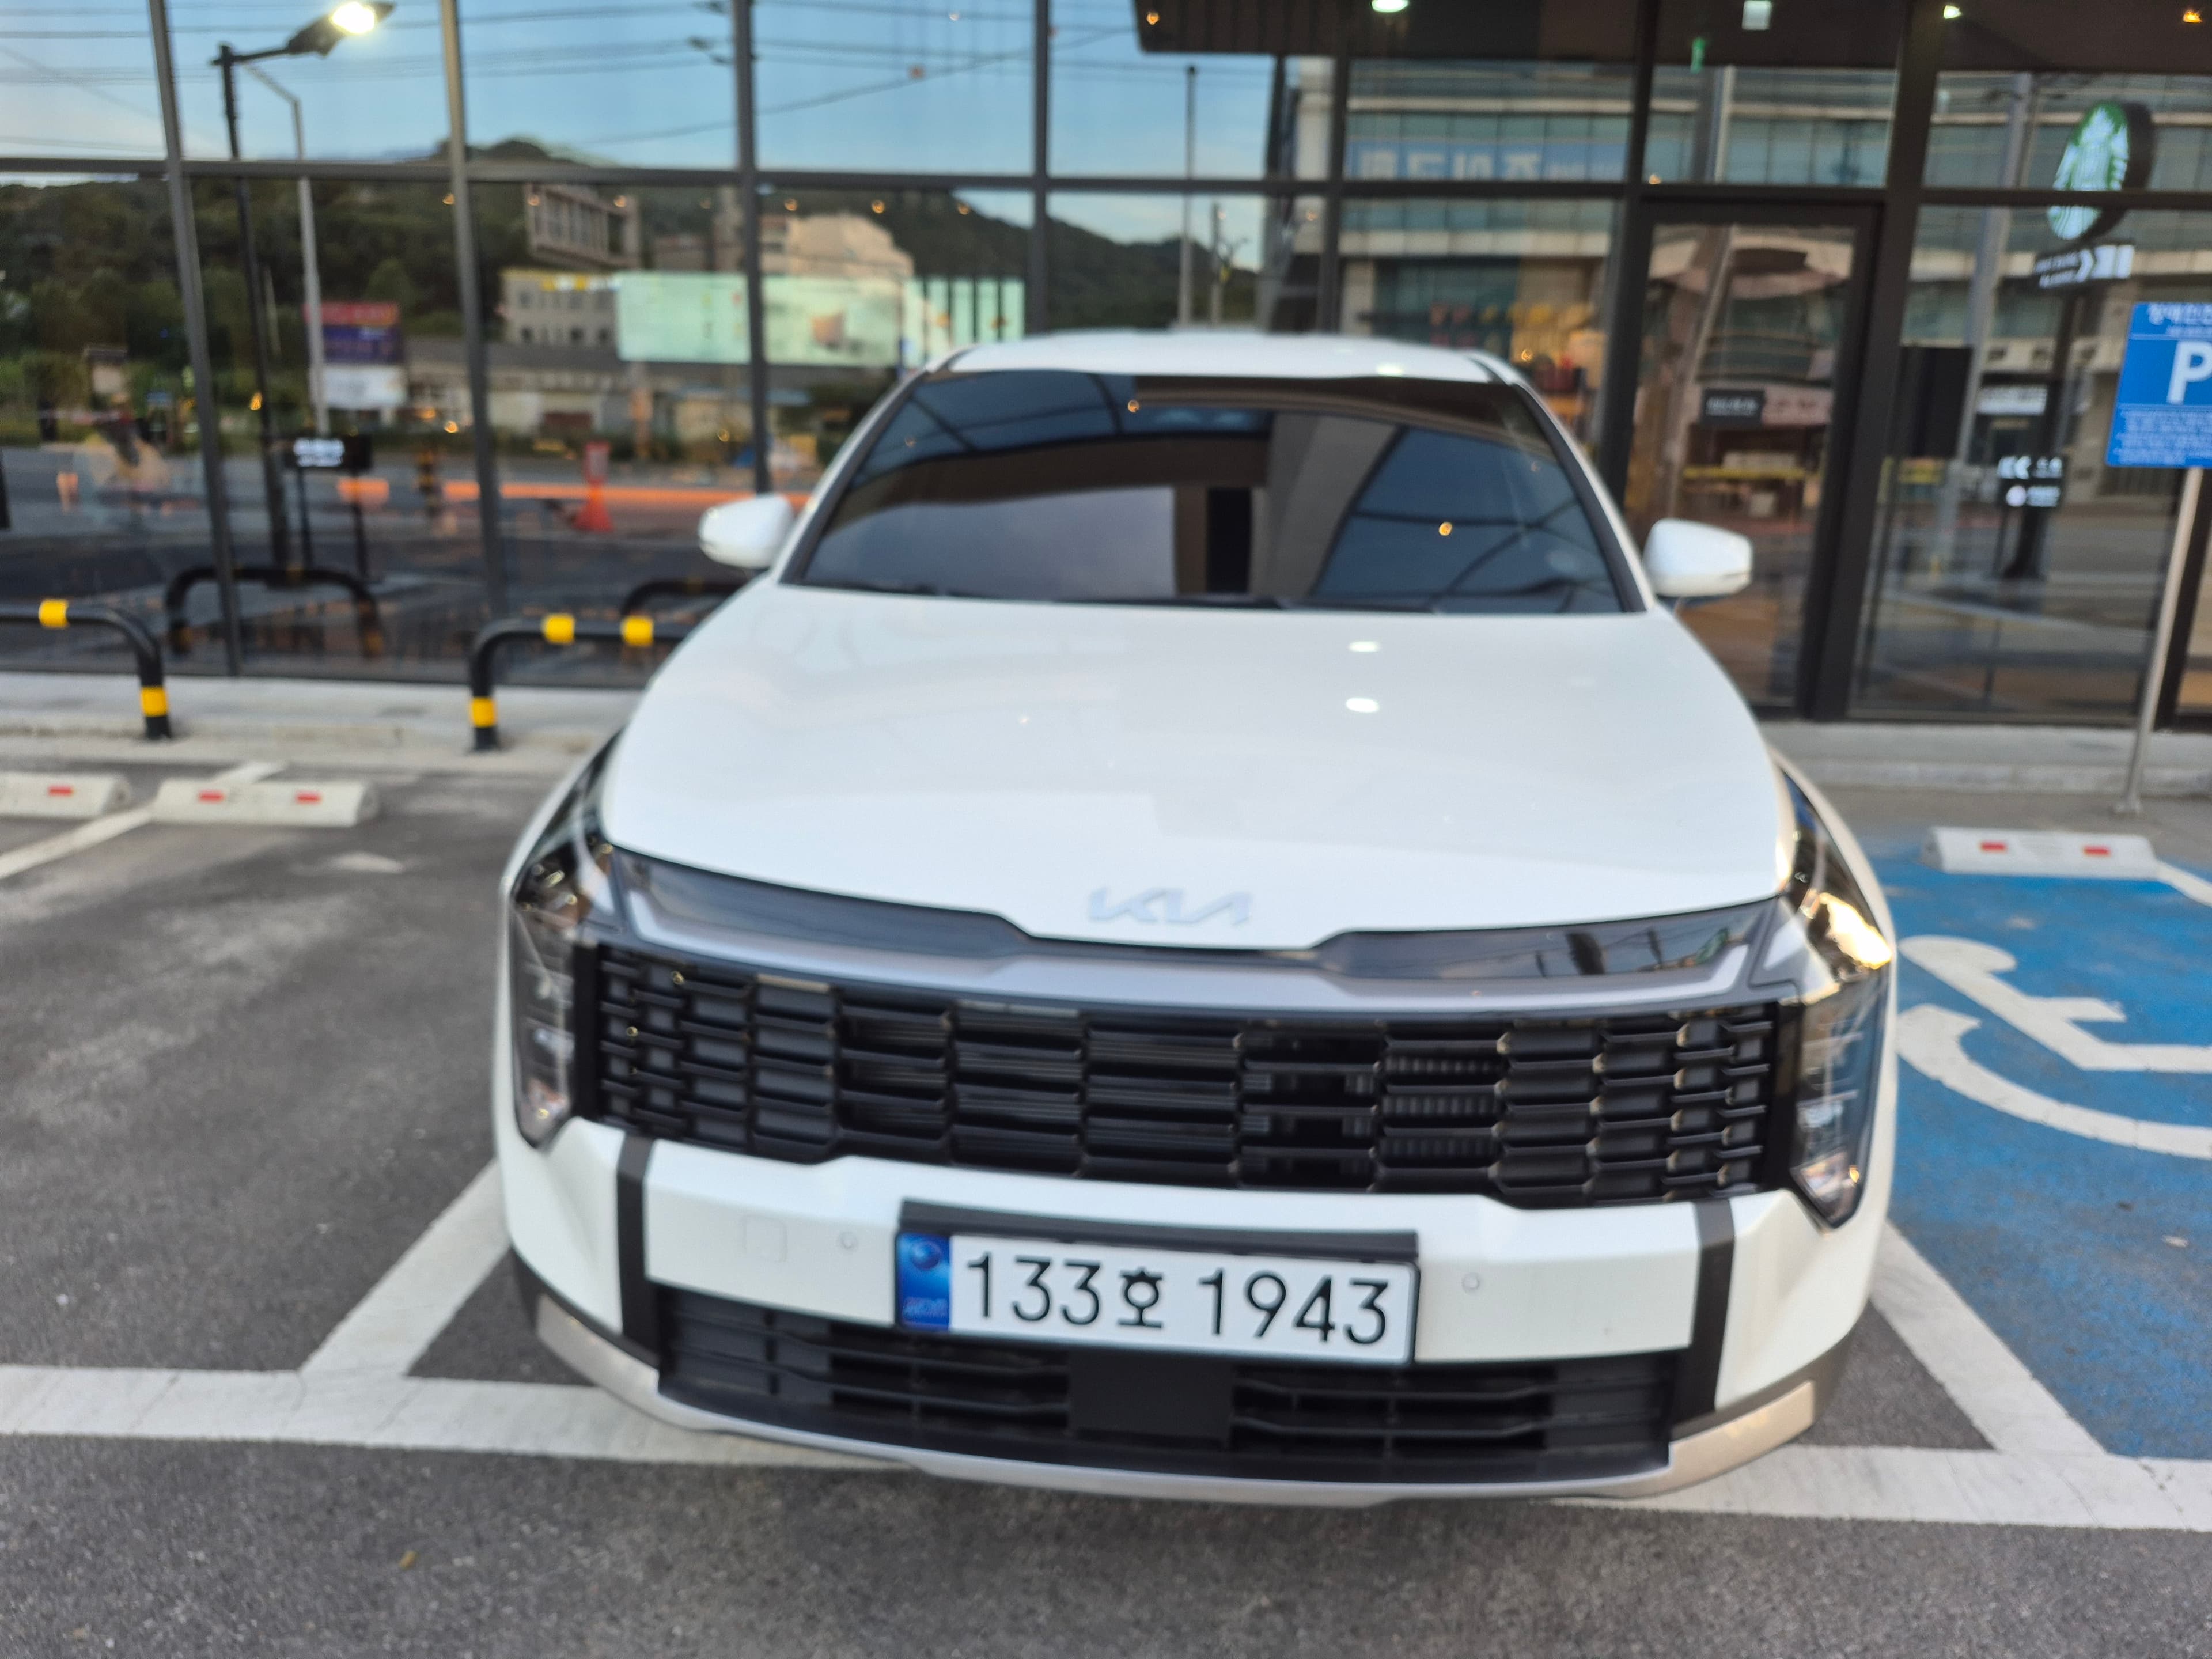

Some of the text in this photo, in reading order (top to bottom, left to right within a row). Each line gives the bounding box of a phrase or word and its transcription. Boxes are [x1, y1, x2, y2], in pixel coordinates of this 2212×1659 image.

[2167, 340, 2212, 404] P
[1089, 887, 1252, 927] KIA
[968, 1252, 1389, 1345] 133호 1943
